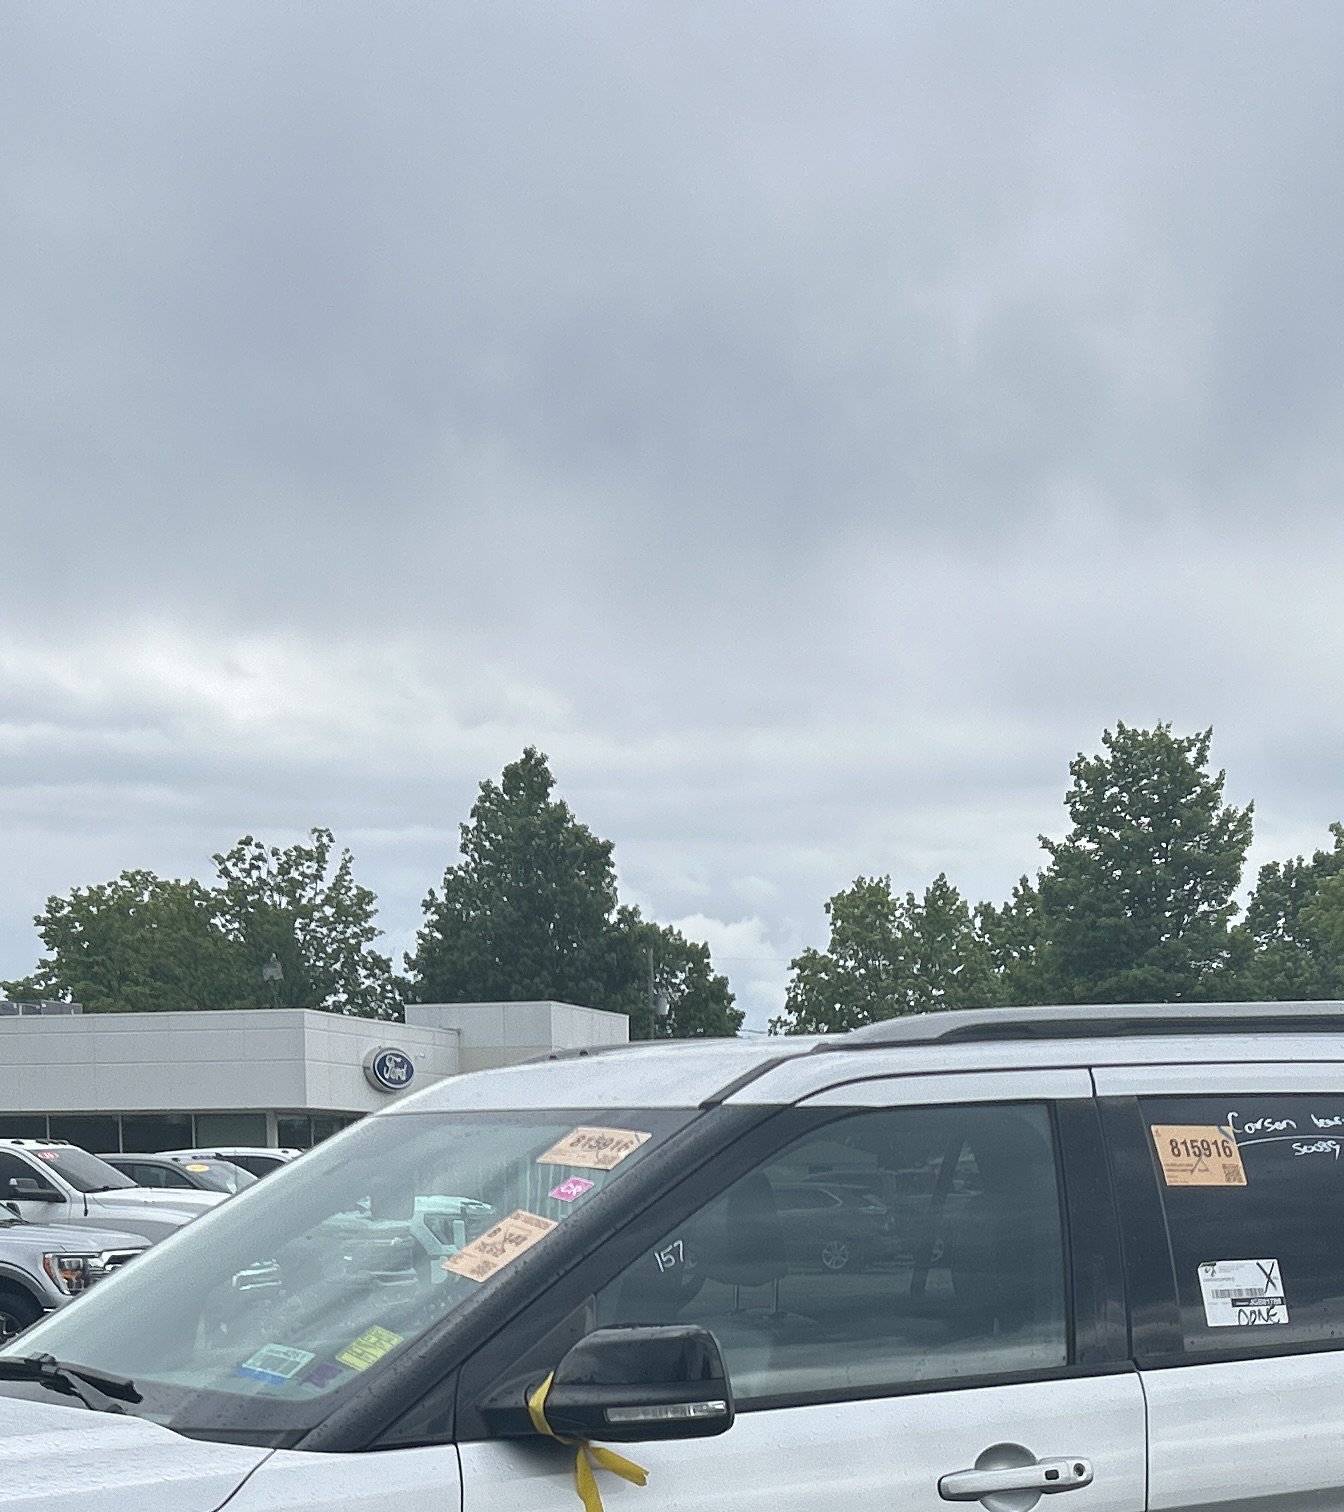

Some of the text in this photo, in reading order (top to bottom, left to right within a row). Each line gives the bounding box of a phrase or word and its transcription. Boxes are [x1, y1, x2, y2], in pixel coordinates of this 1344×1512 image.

[383, 1055, 407, 1080] Ford
[1169, 1139, 1233, 1158] 815916
[654, 1239, 684, 1273] 157
